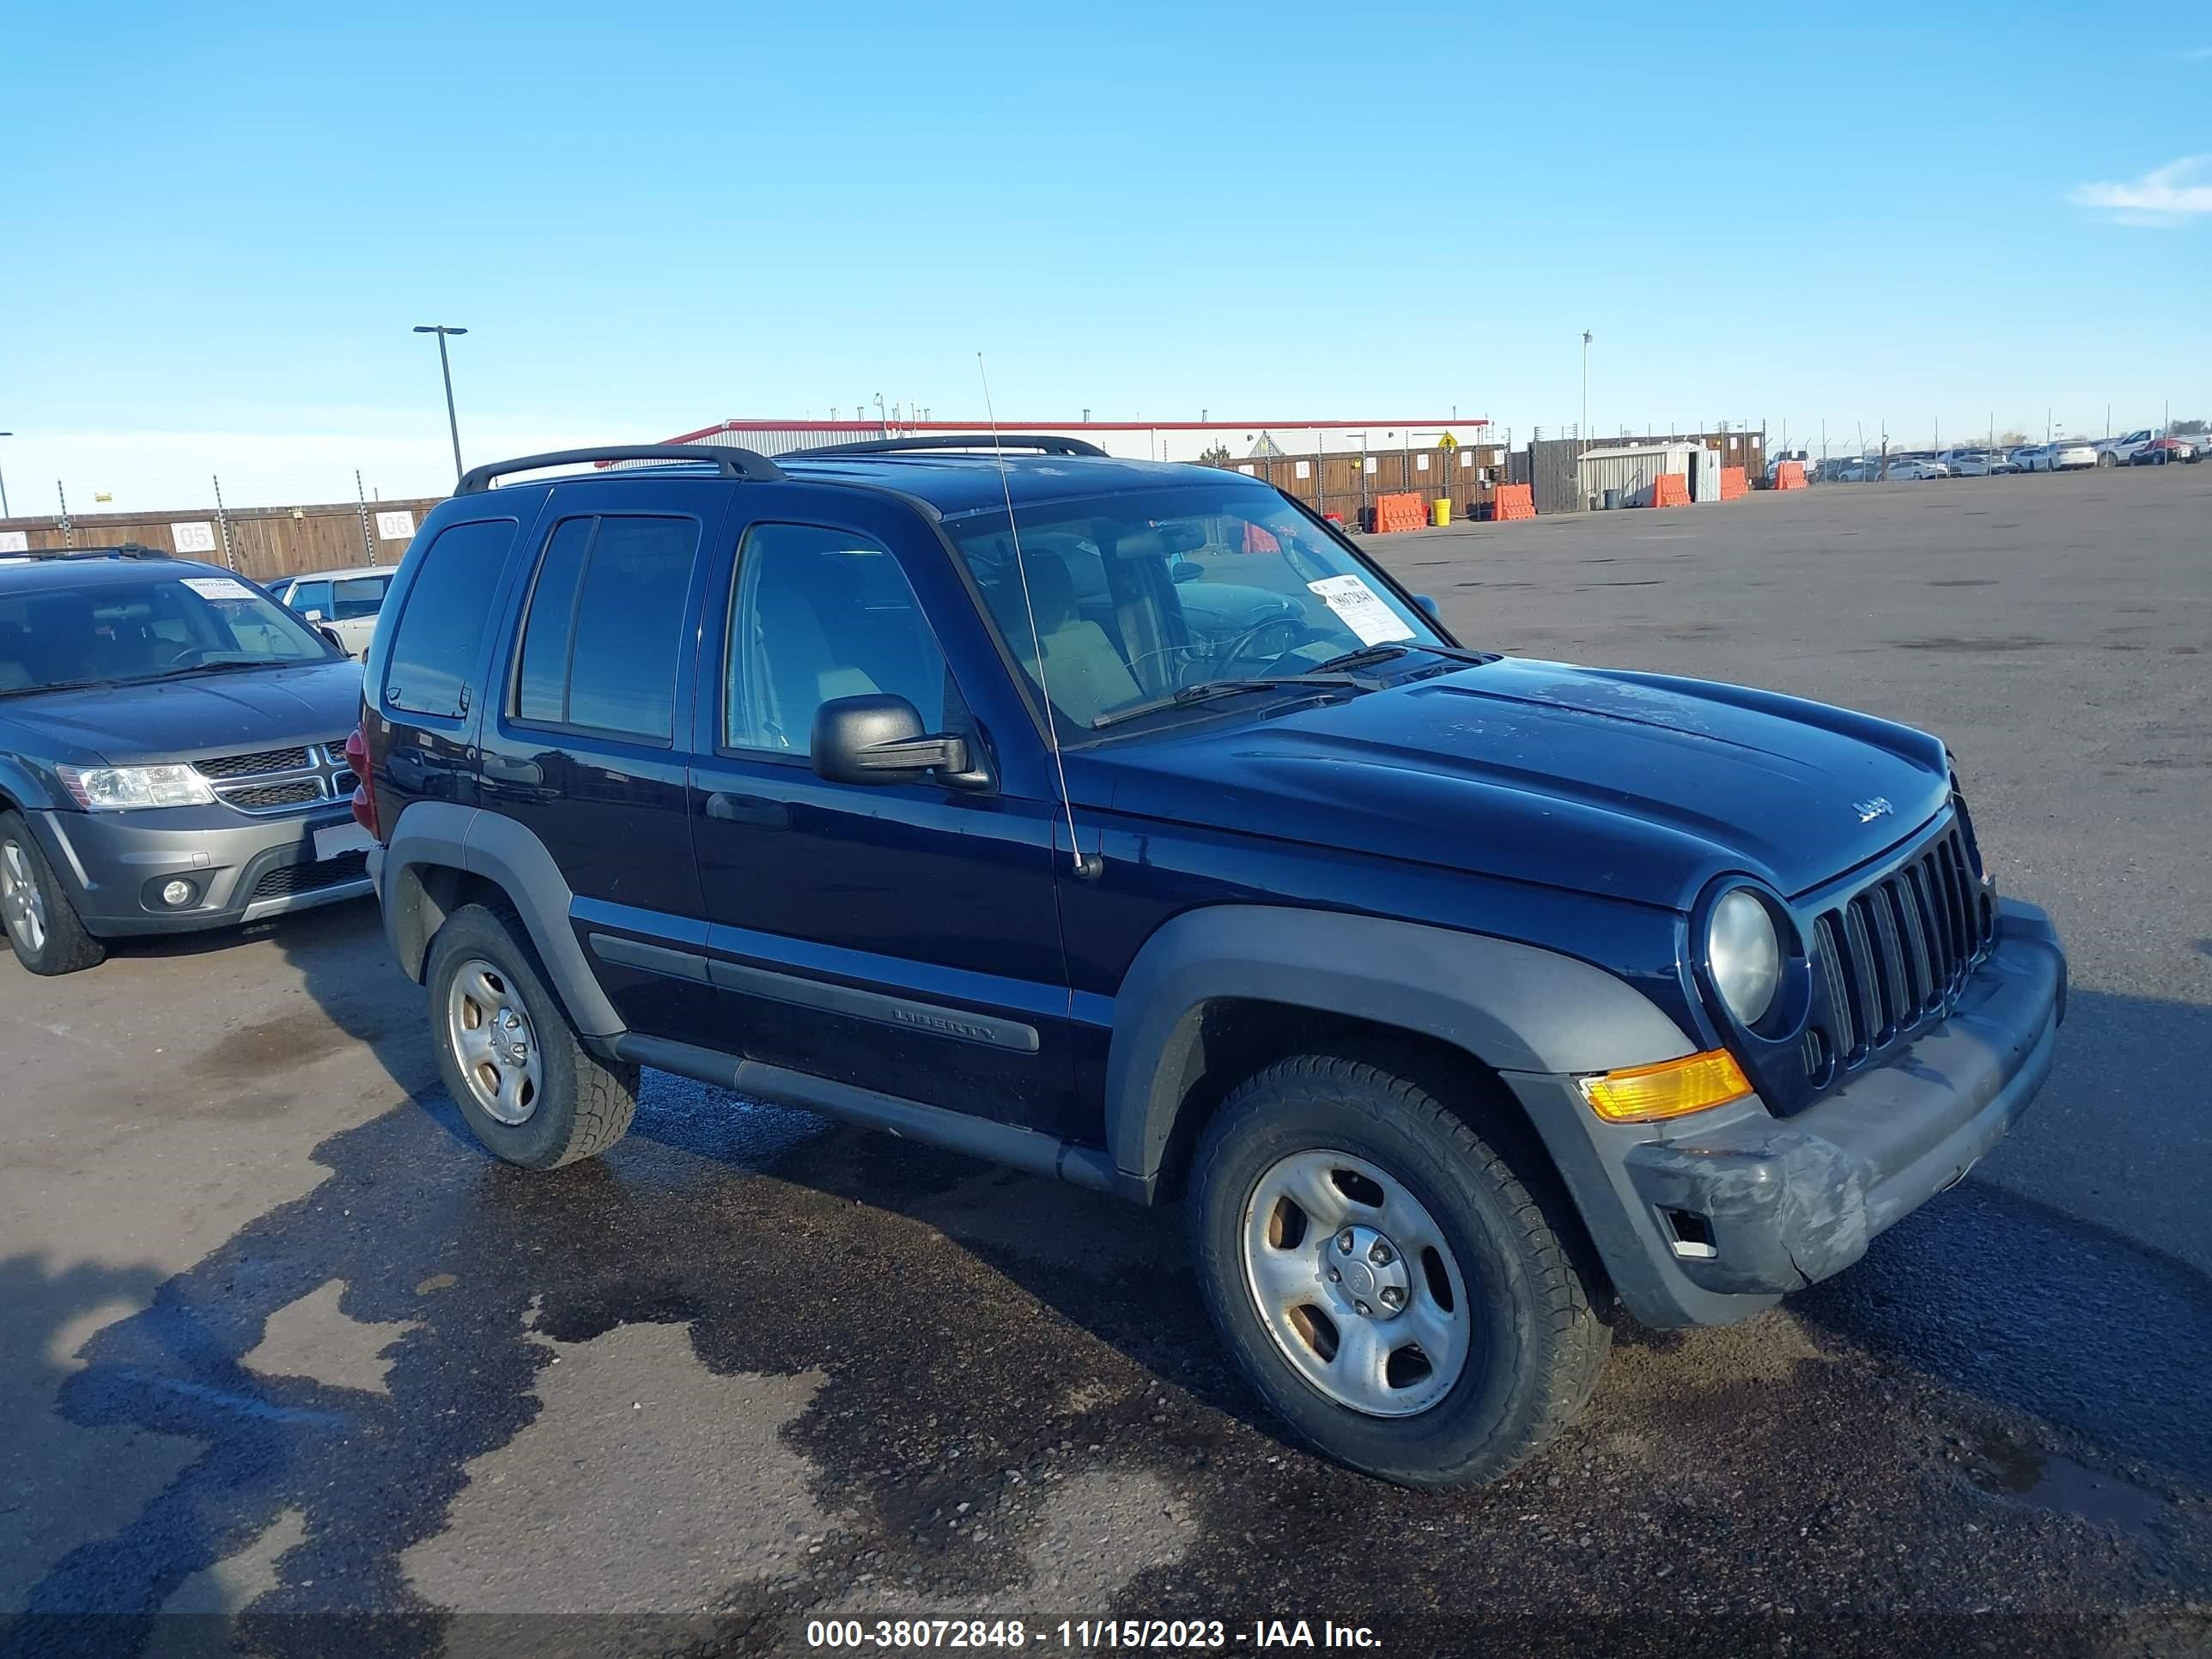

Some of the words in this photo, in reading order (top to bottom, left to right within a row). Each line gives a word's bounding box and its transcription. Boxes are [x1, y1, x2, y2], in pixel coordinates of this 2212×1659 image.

[384, 515, 409, 535] 06
[179, 527, 208, 547] 05
[893, 1009, 996, 1039] LIBERTY
